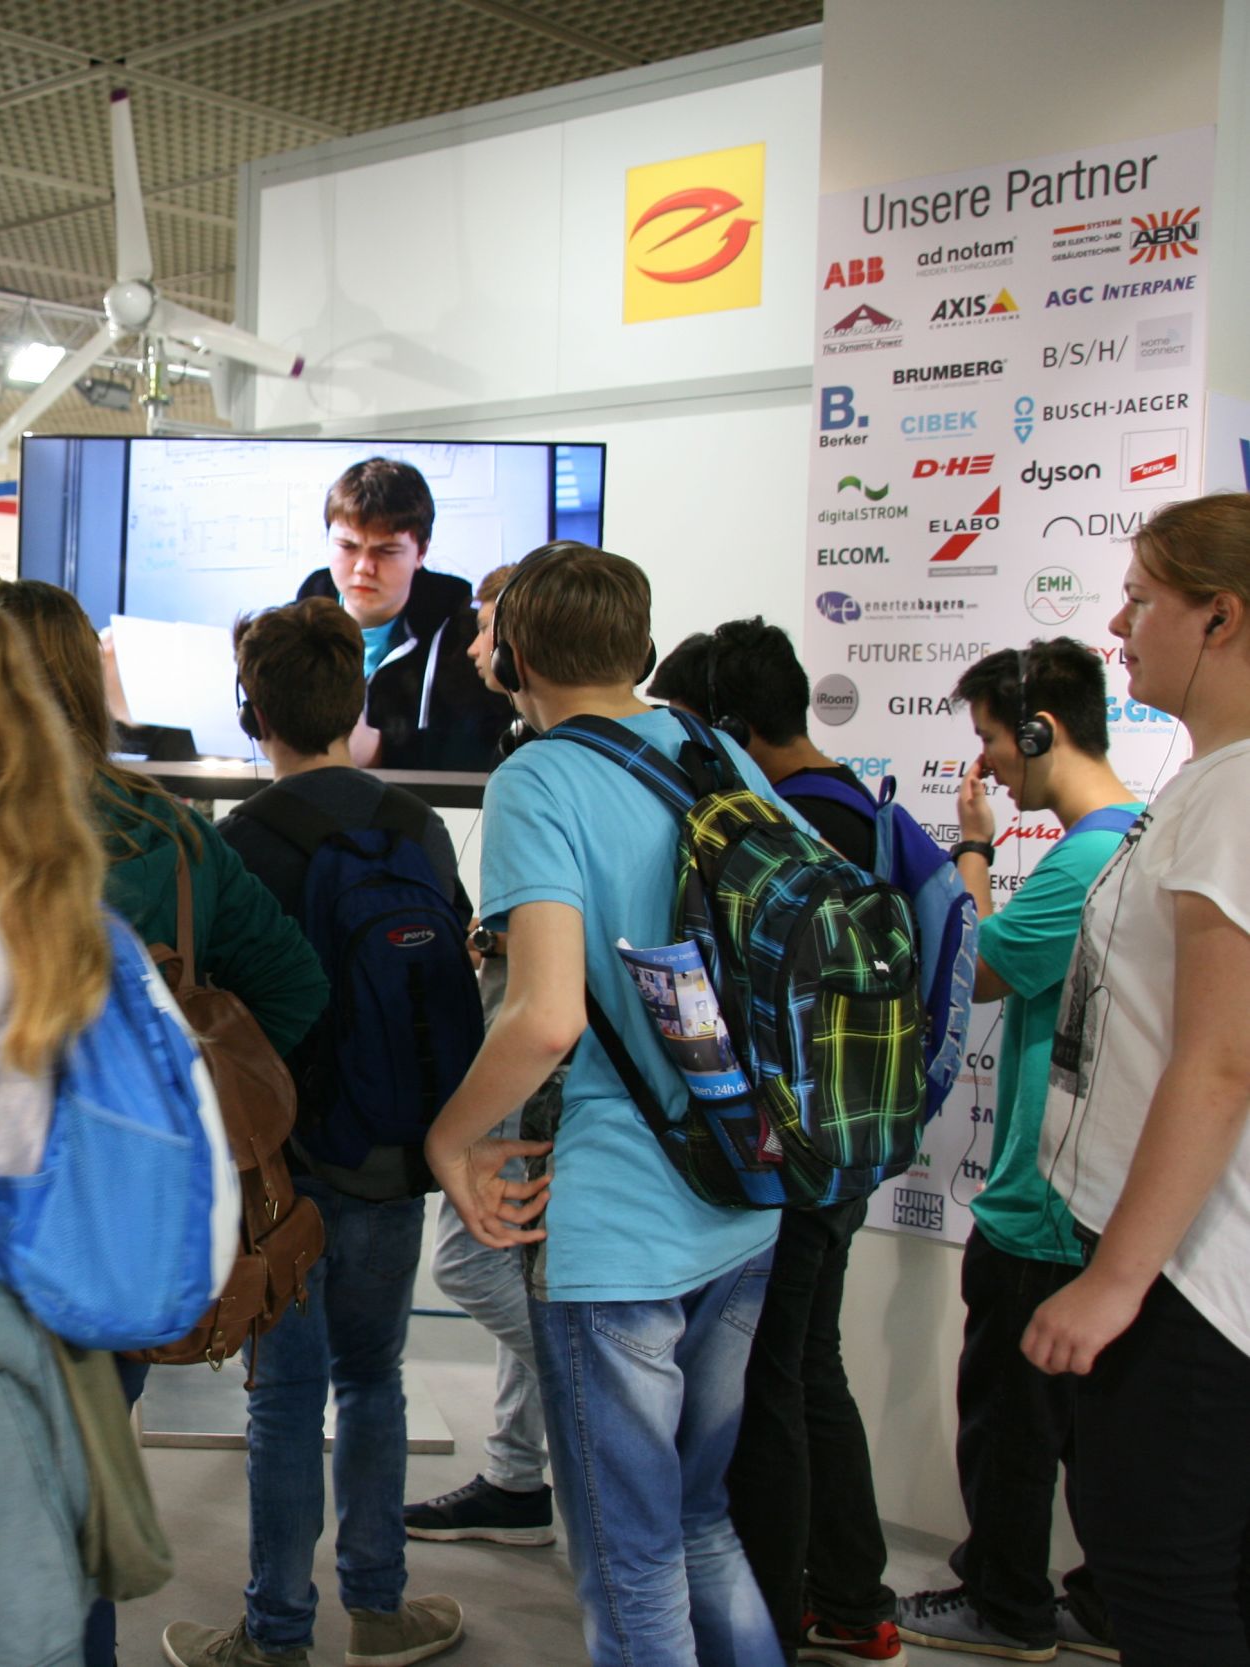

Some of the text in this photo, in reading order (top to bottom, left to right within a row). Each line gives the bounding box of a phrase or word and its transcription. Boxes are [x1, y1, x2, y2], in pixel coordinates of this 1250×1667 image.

[862, 155, 1158, 235] Unsere Partner
[1086, 218, 1123, 231] SYSTEME
[1105, 232, 1122, 241] UND
[1131, 222, 1198, 249] ABN
[917, 240, 1015, 266] ad notam
[823, 256, 885, 290] ABB
[1045, 275, 1198, 309] AGC INTERPANE
[929, 294, 987, 322] AXIS
[1042, 335, 1129, 369] B/S/H/
[892, 360, 1005, 385] BRUMBERG
[1042, 393, 1190, 421] BUSCH-JAEGER
[900, 410, 979, 435] CIBEK
[819, 433, 869, 448] Berker
[1020, 460, 1102, 490] dyson
[929, 516, 1001, 533] ELABO
[817, 546, 890, 566] ELCOM.
[1036, 575, 1072, 592] EMH
[847, 642, 991, 663] FUTURE SHAPE
[816, 692, 854, 705] iRoom
[888, 696, 953, 715] GIRA
[920, 823, 960, 843] NG
[992, 816, 1062, 847] jura
[990, 874, 1027, 891] EKES
[966, 1052, 995, 1071] CO
[970, 1104, 994, 1124] SA
[895, 1188, 943, 1213] WINK
[894, 1206, 942, 1230] HAUS
